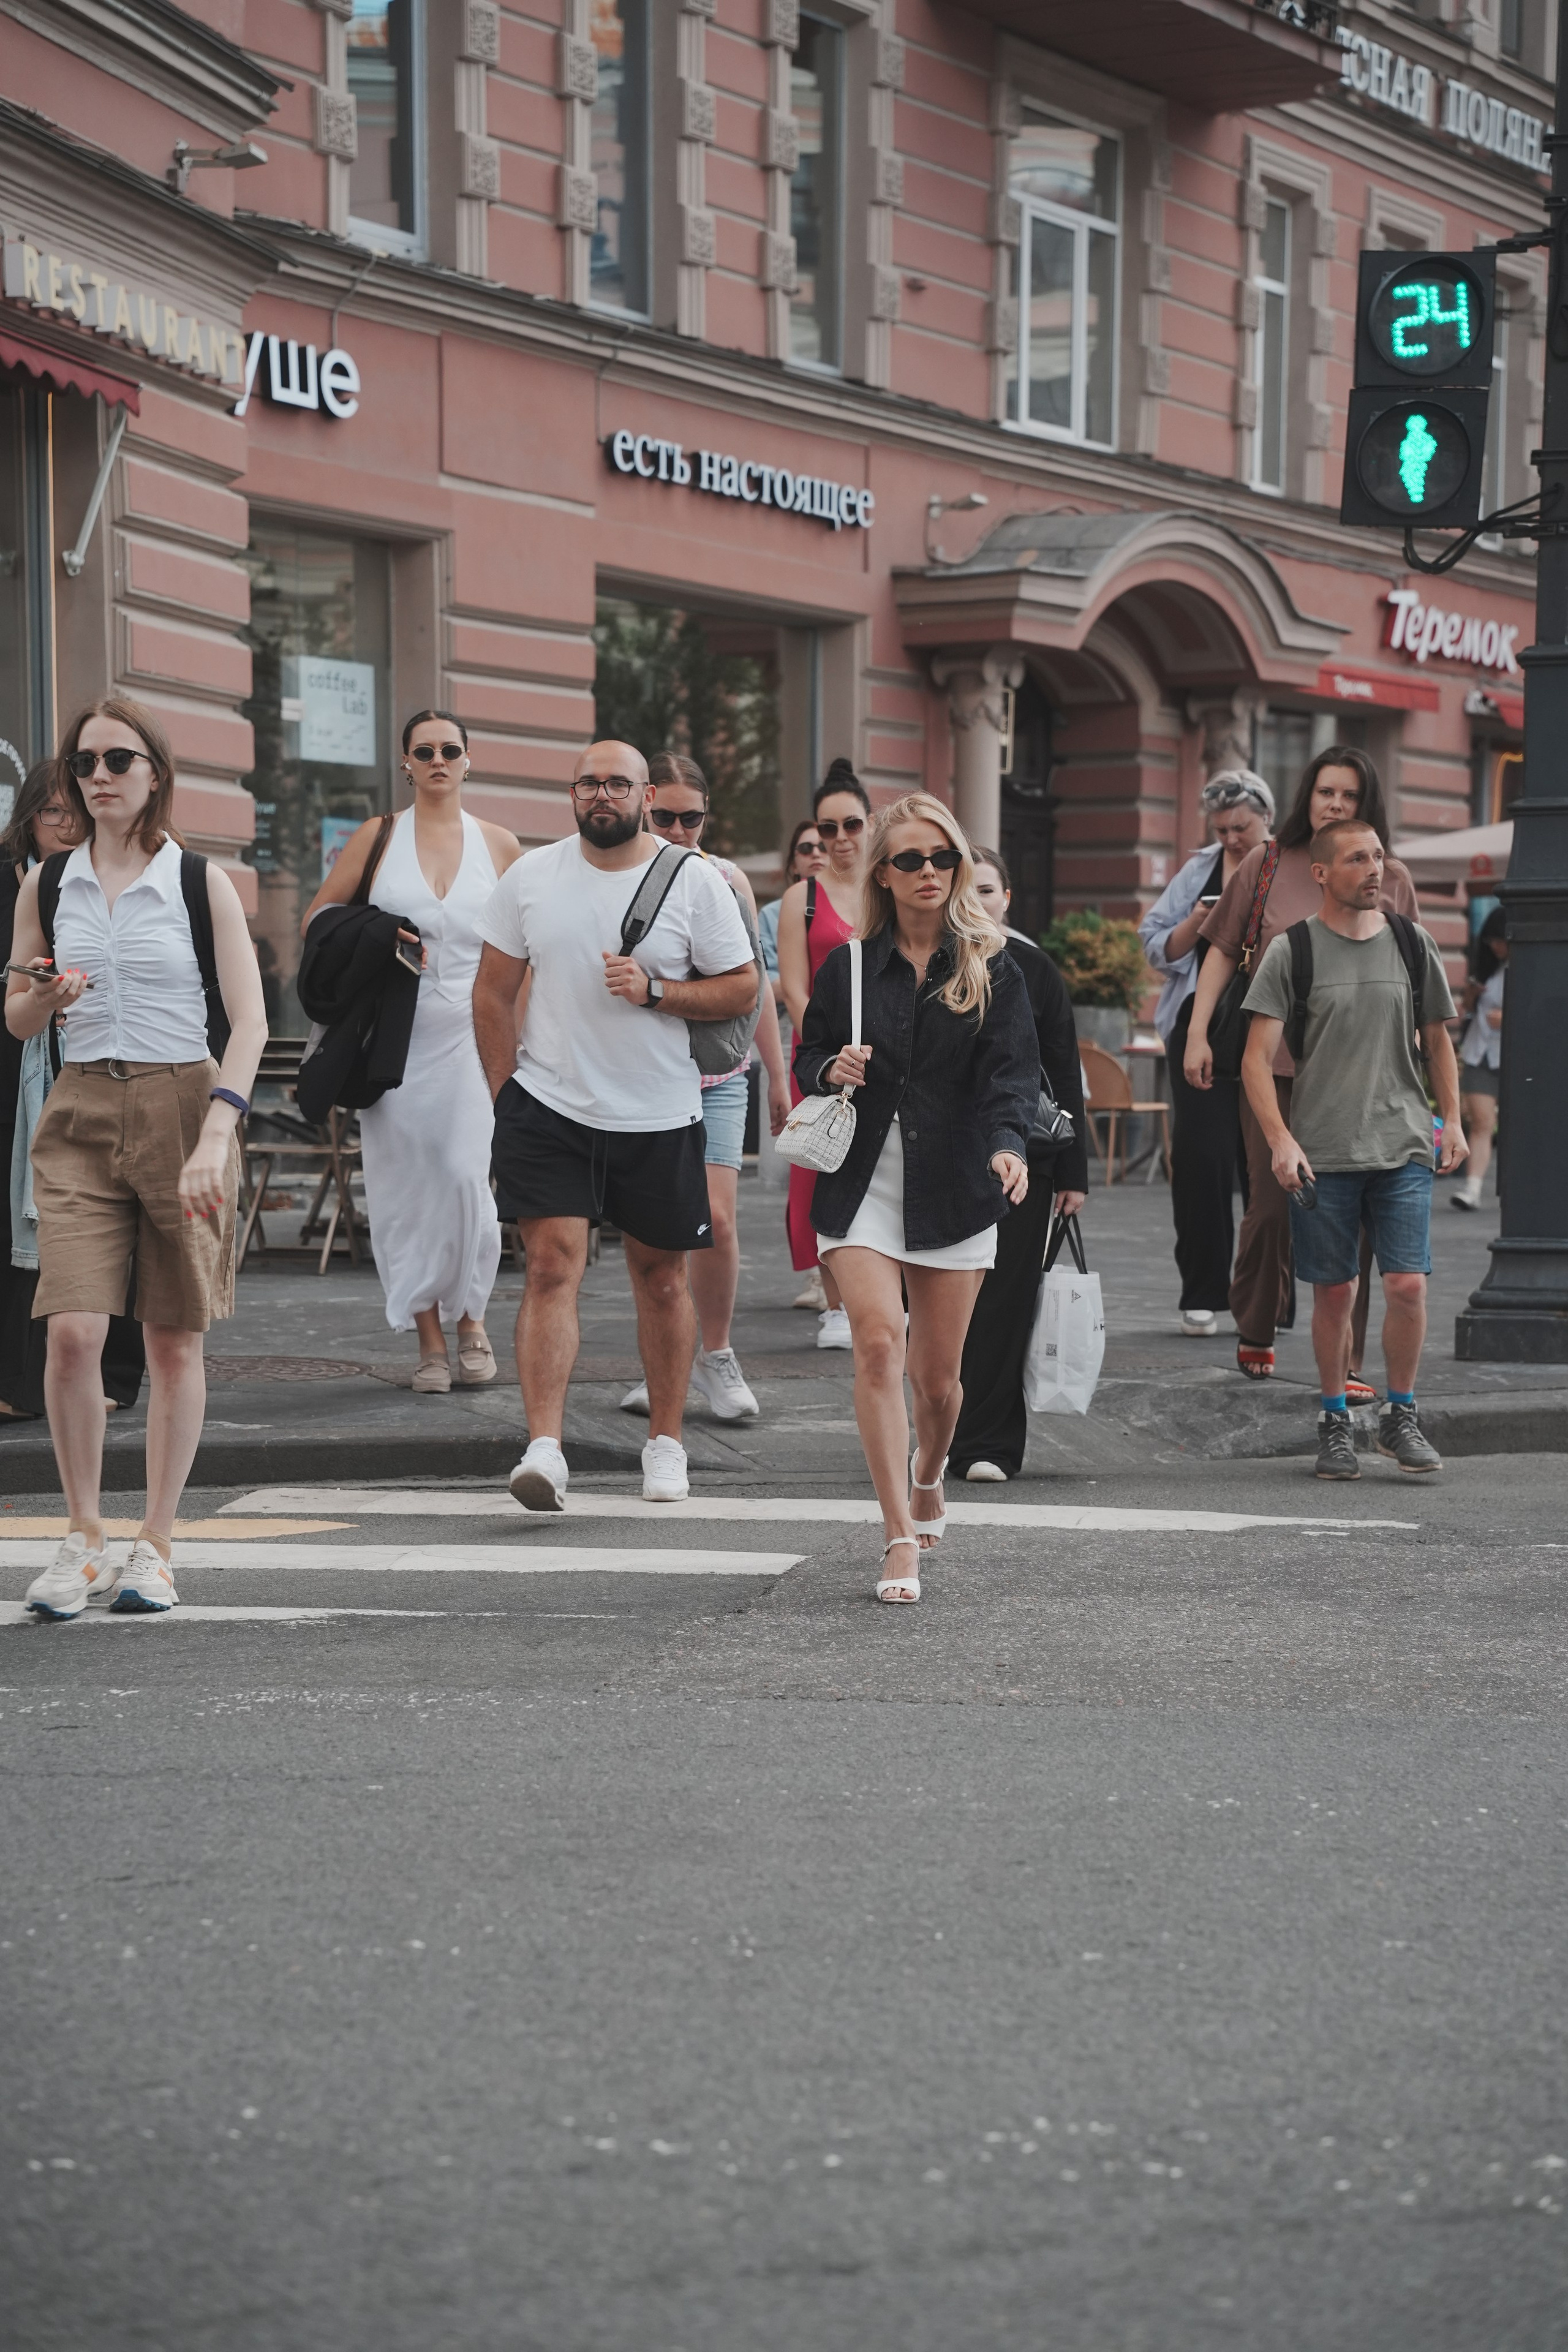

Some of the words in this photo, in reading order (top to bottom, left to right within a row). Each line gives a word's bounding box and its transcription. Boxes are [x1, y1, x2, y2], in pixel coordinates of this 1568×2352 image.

[23, 244, 247, 385] RESTAURANT
[1391, 282, 1470, 357] 24
[613, 429, 692, 484] есть
[699, 450, 875, 532] настоящее
[1387, 589, 1518, 674] Теремок
[307, 671, 357, 693] coffee
